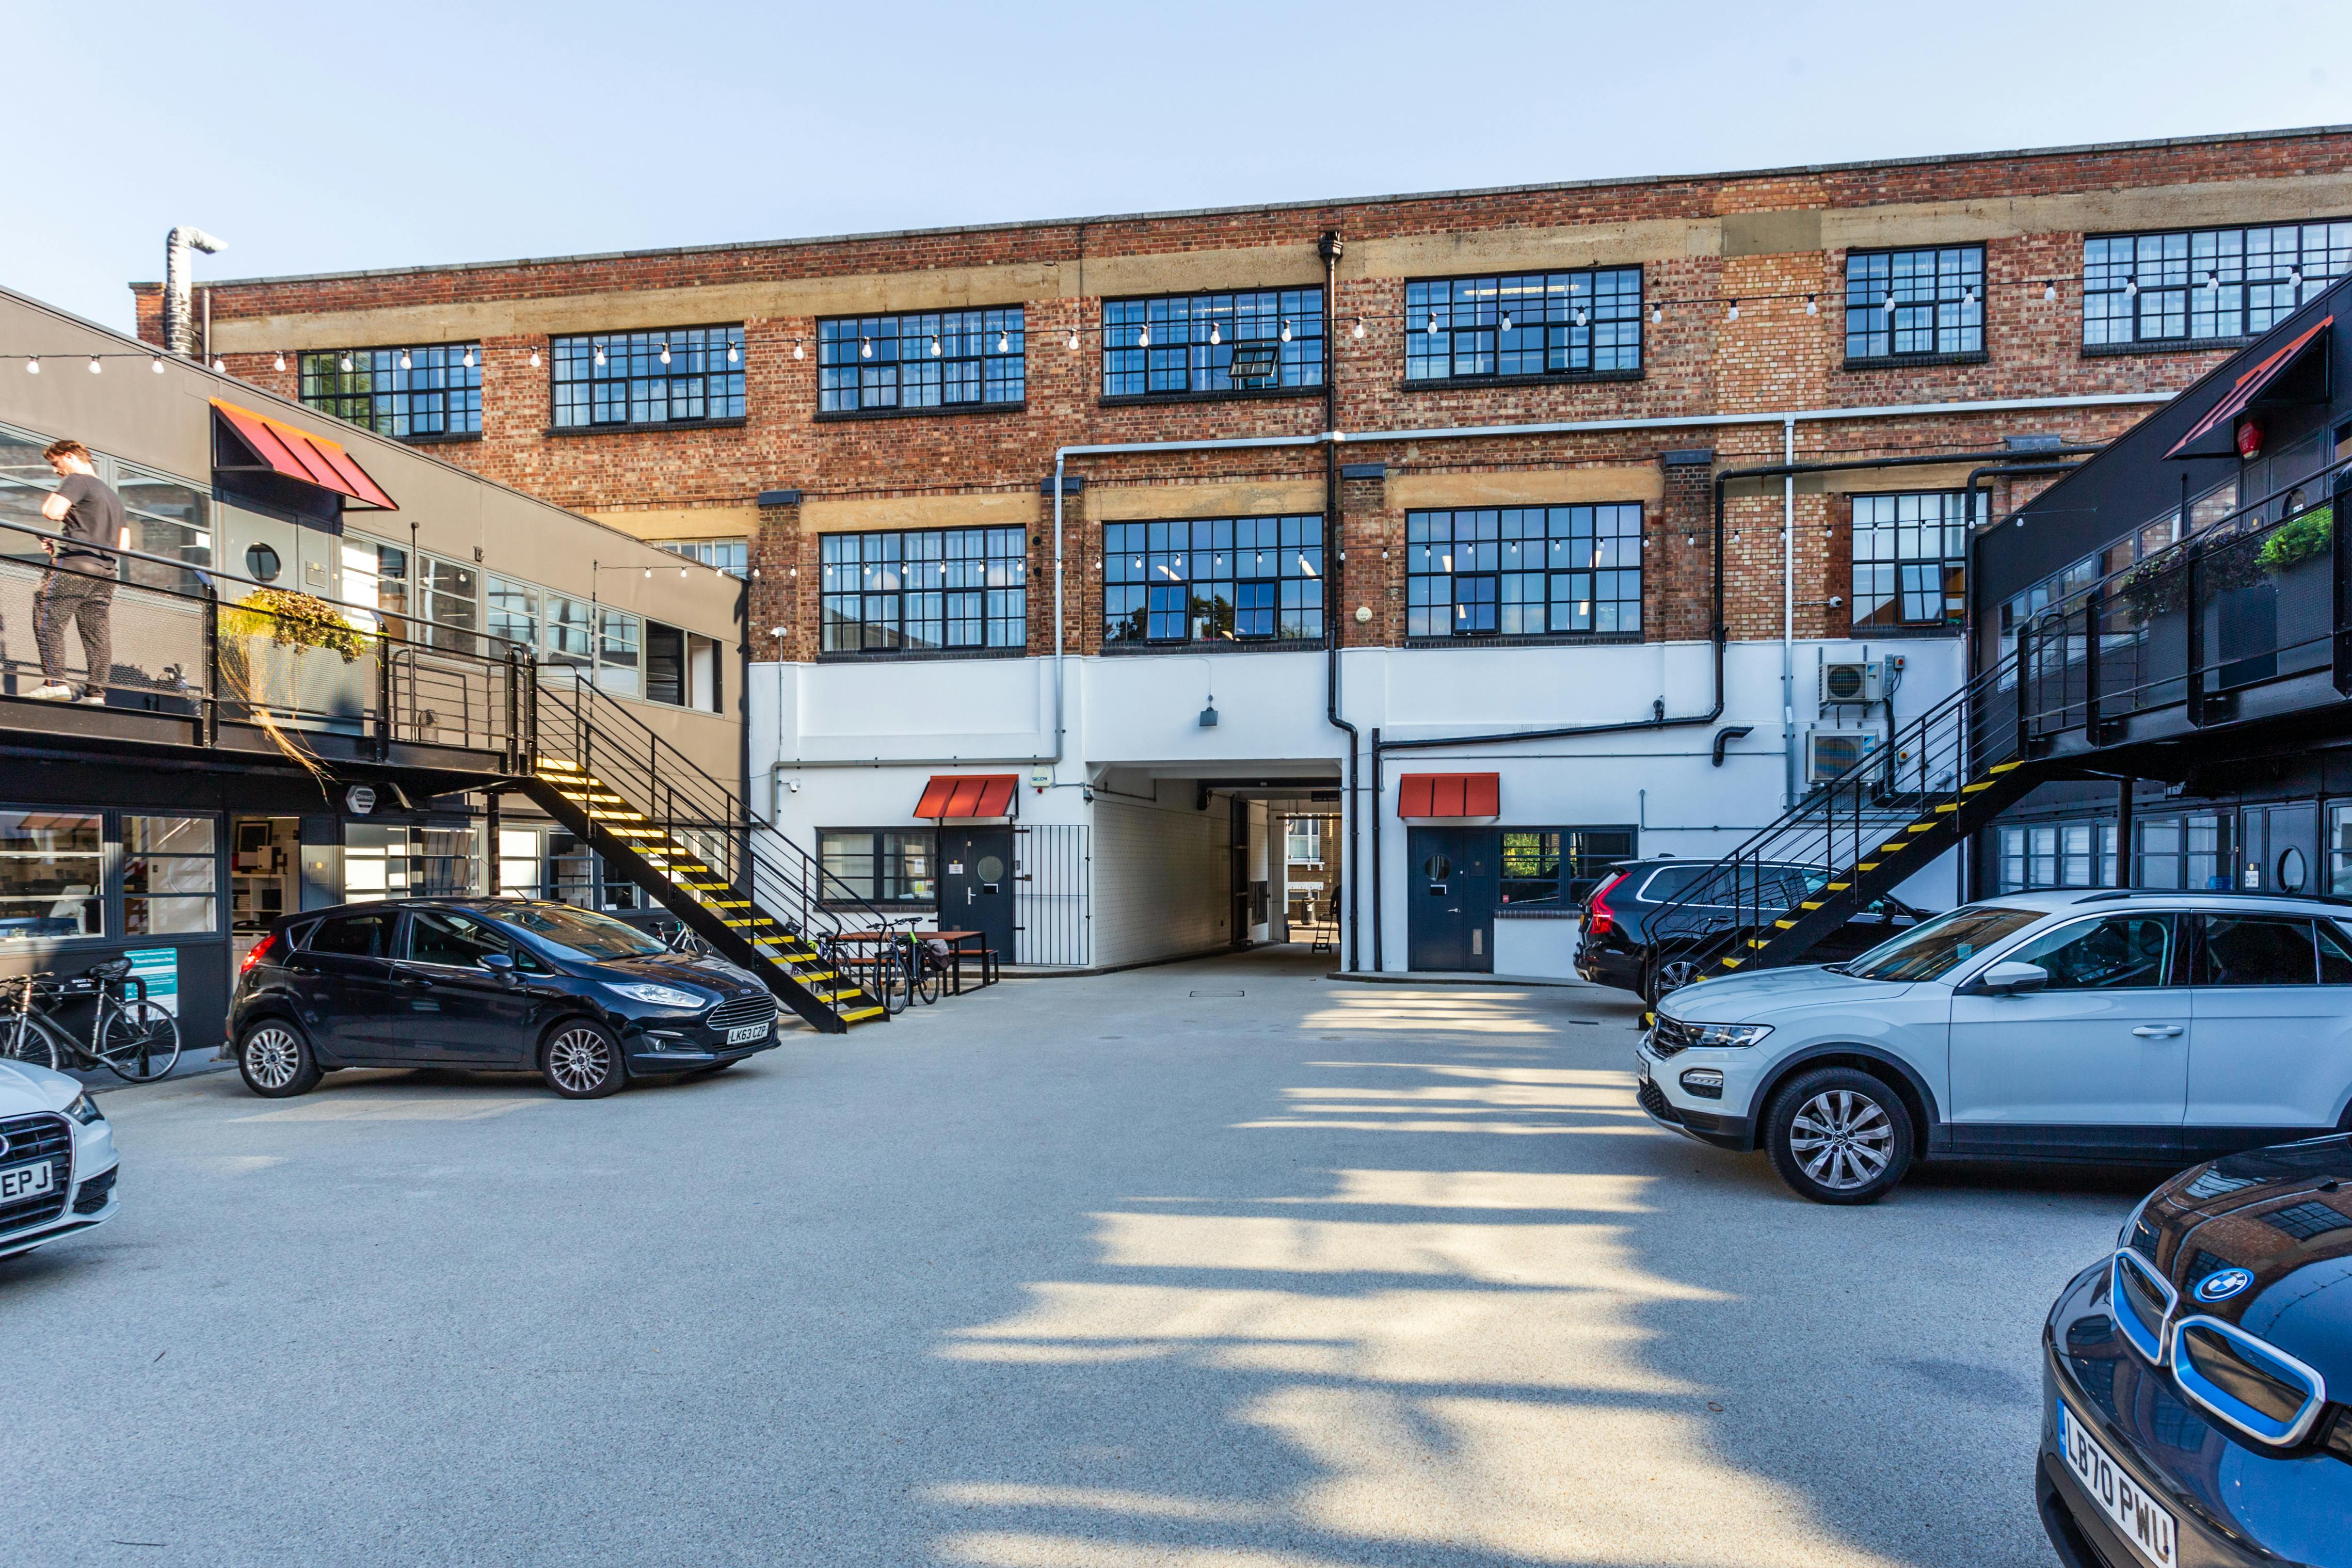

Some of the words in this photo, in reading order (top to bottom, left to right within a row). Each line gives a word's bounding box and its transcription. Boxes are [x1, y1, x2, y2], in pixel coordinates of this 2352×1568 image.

[731, 1029, 752, 1042] LK63
[753, 1025, 766, 1038] CZP
[2, 1165, 48, 1198] EPJ
[2067, 1416, 2114, 1507] LB70
[2119, 1476, 2169, 1564] PWU
